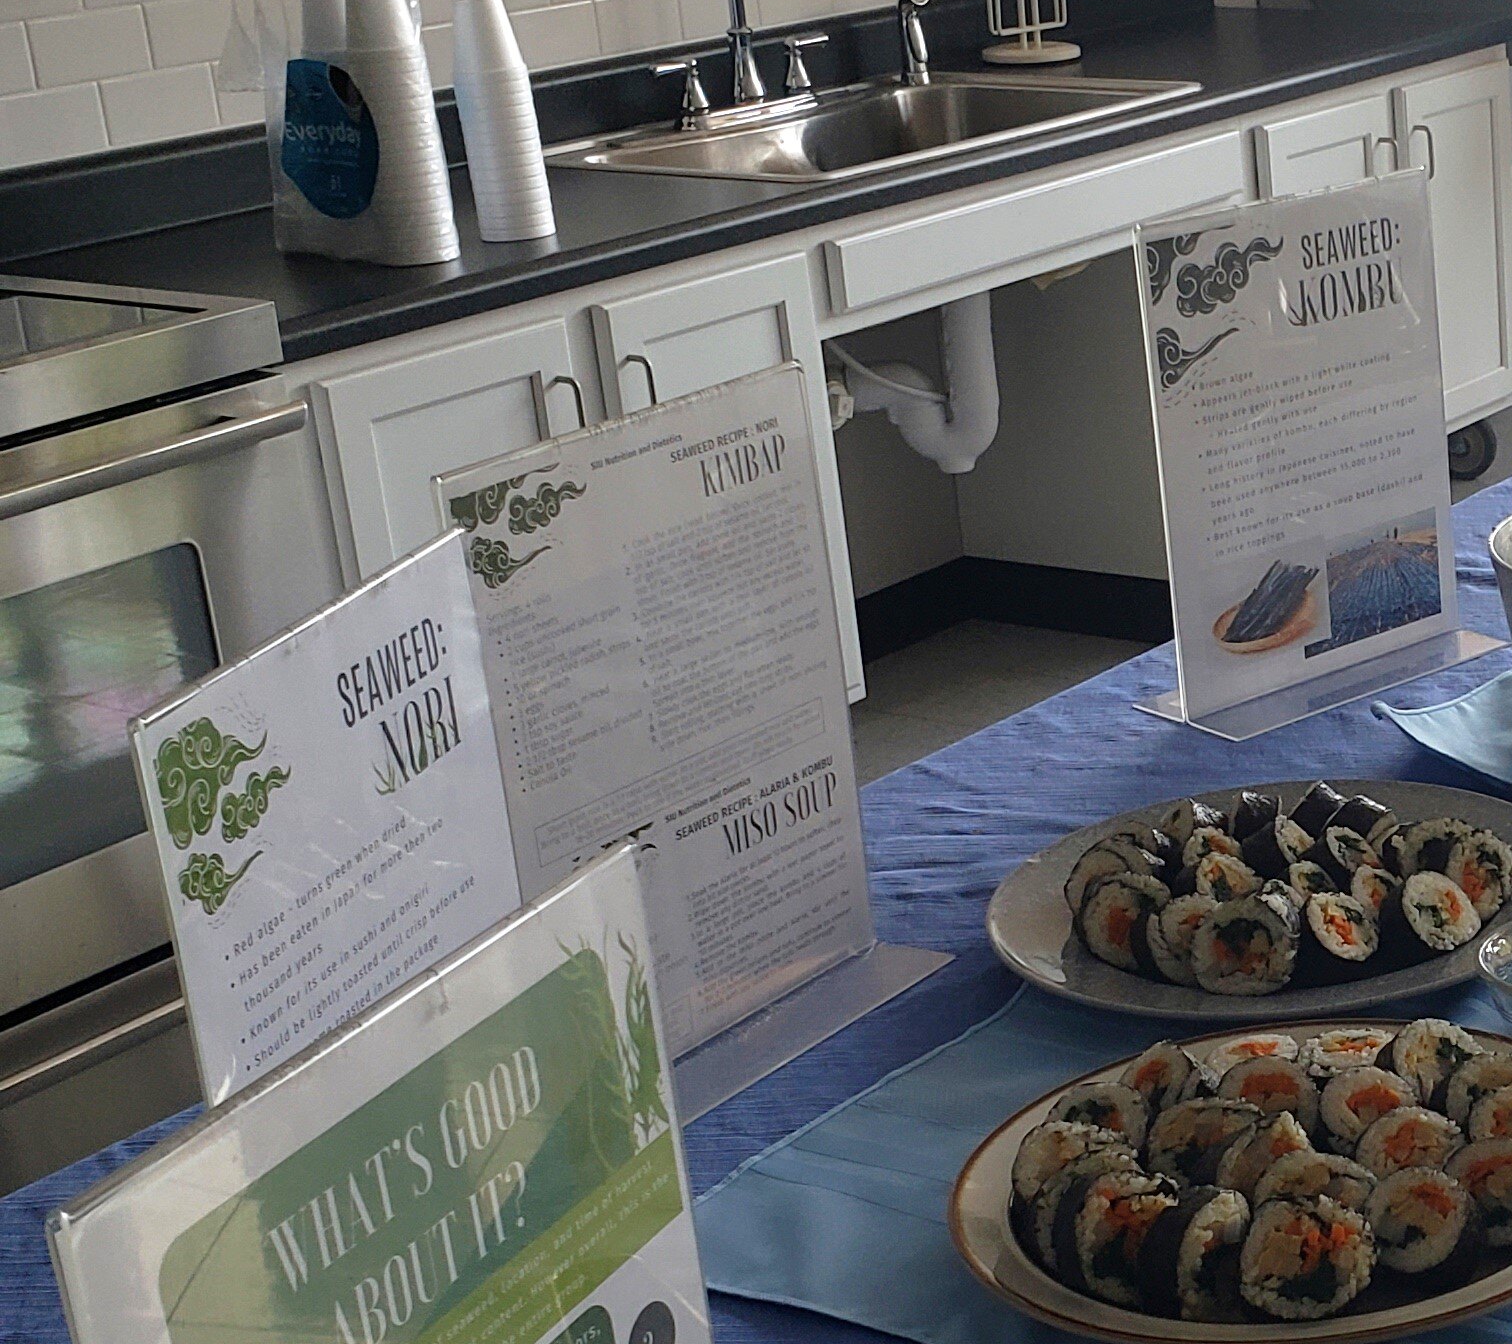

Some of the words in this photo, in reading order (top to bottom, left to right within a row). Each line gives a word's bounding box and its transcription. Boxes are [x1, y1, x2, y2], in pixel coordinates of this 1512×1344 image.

[1300, 214, 1401, 271] SEAWEED:
[1298, 256, 1405, 327] KOMBU
[638, 442, 651, 455] and
[669, 438, 715, 464] SEAWEED
[716, 426, 749, 448] RECIPE
[755, 416, 778, 434] NORI
[699, 431, 788, 498] KIMBAP
[337, 618, 447, 728] SEAWEED:
[378, 675, 461, 787] NORI
[674, 811, 719, 842] SEAWEED
[721, 794, 752, 818] RECIPE
[758, 776, 790, 800] ALARIA
[791, 772, 799, 783] &
[800, 754, 833, 779] KOMBU
[722, 799, 779, 858] MISO
[782, 769, 839, 829] SOUP
[232, 930, 254, 959] Red
[256, 910, 286, 941] algae
[295, 882, 323, 911] turns
[324, 856, 352, 891] green
[354, 837, 380, 865] when
[380, 813, 406, 844] dried
[238, 963, 259, 987] Has
[261, 941, 287, 969] been
[289, 916, 318, 947] eaten
[320, 906, 331, 922] in
[362, 868, 377, 888] for
[379, 847, 403, 875] more
[243, 963, 293, 1015] thousand
[294, 941, 323, 975] years
[248, 1006, 283, 1041] Known
[285, 991, 301, 1010] for
[303, 977, 318, 995] its
[320, 959, 338, 982] use
[339, 951, 349, 966] in
[352, 925, 378, 956] sushi
[379, 909, 397, 933] and
[399, 882, 429, 918] onigiri
[253, 1026, 290, 1068] Should
[292, 1017, 305, 1035] be
[307, 988, 341, 1023] lightly
[342, 953, 379, 994] toasted
[381, 931, 403, 961] until
[405, 915, 428, 940] crisp
[428, 889, 458, 921] before
[458, 873, 475, 896] use
[385, 966, 401, 986] the
[404, 933, 439, 973] package
[438, 1045, 542, 1170] GOOD
[468, 1160, 528, 1261] IT?
